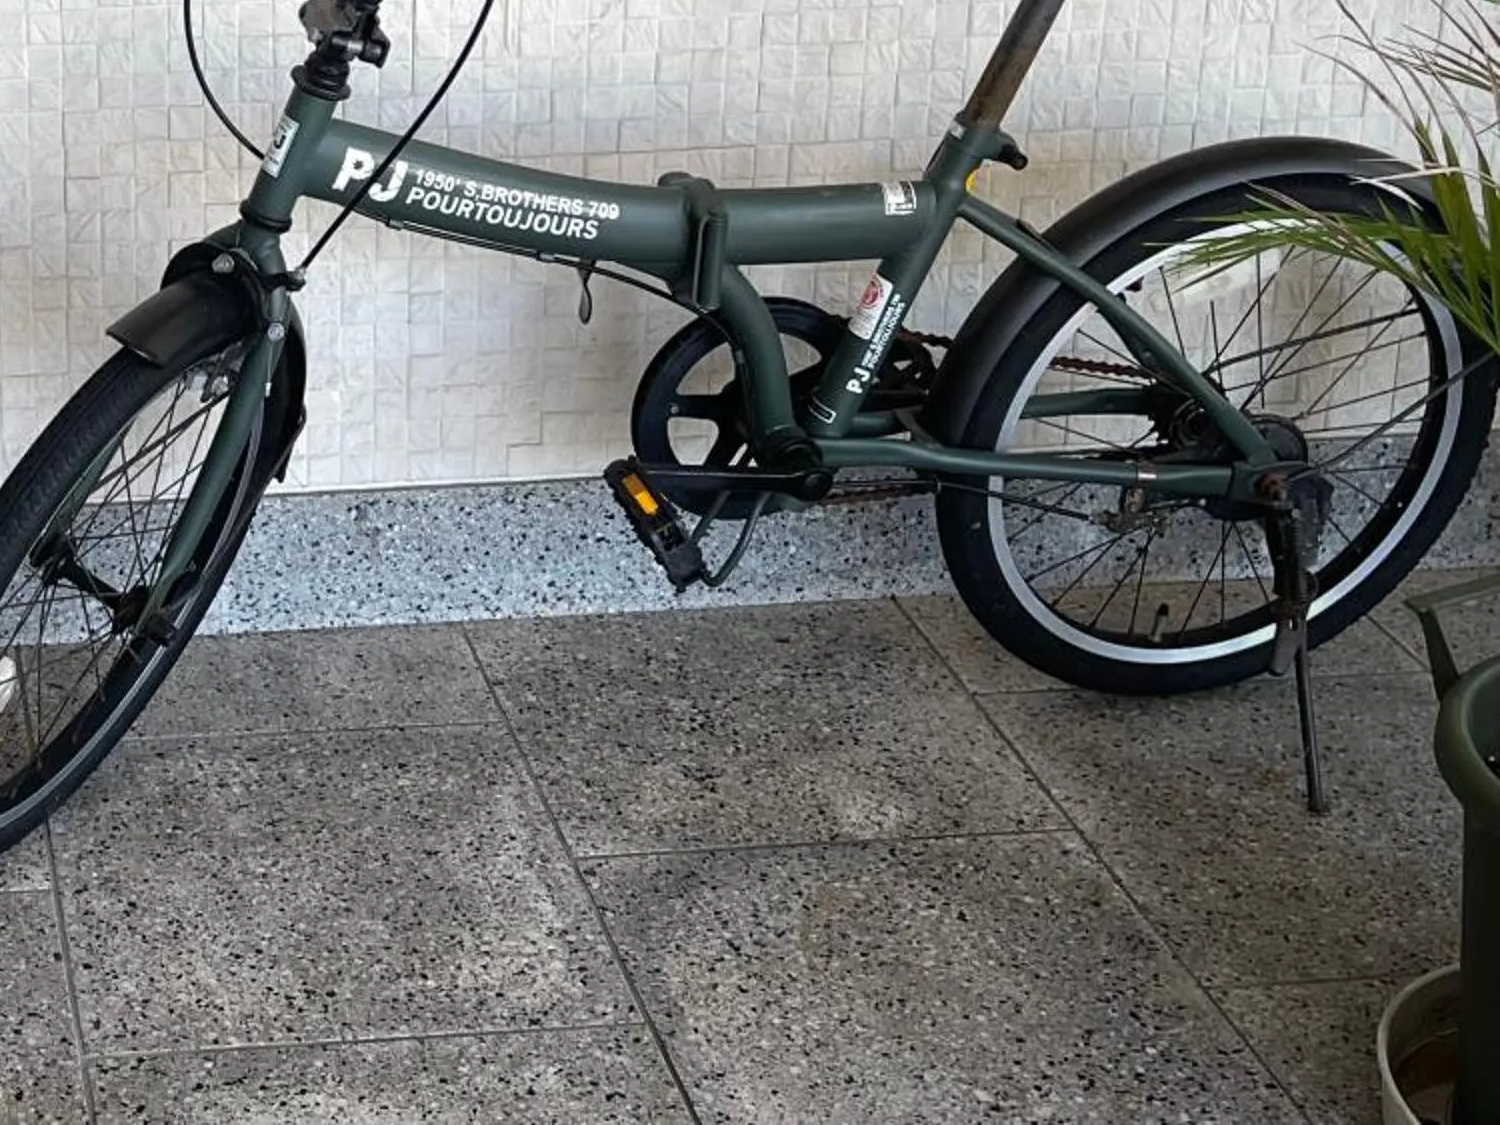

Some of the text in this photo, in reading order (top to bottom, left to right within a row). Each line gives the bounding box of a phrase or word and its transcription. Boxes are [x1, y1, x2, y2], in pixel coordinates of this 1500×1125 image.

[332, 146, 409, 202] PJ
[405, 186, 600, 240] POURTOUJOURS
[587, 201, 620, 220] 709
[845, 366, 871, 394] PJ
